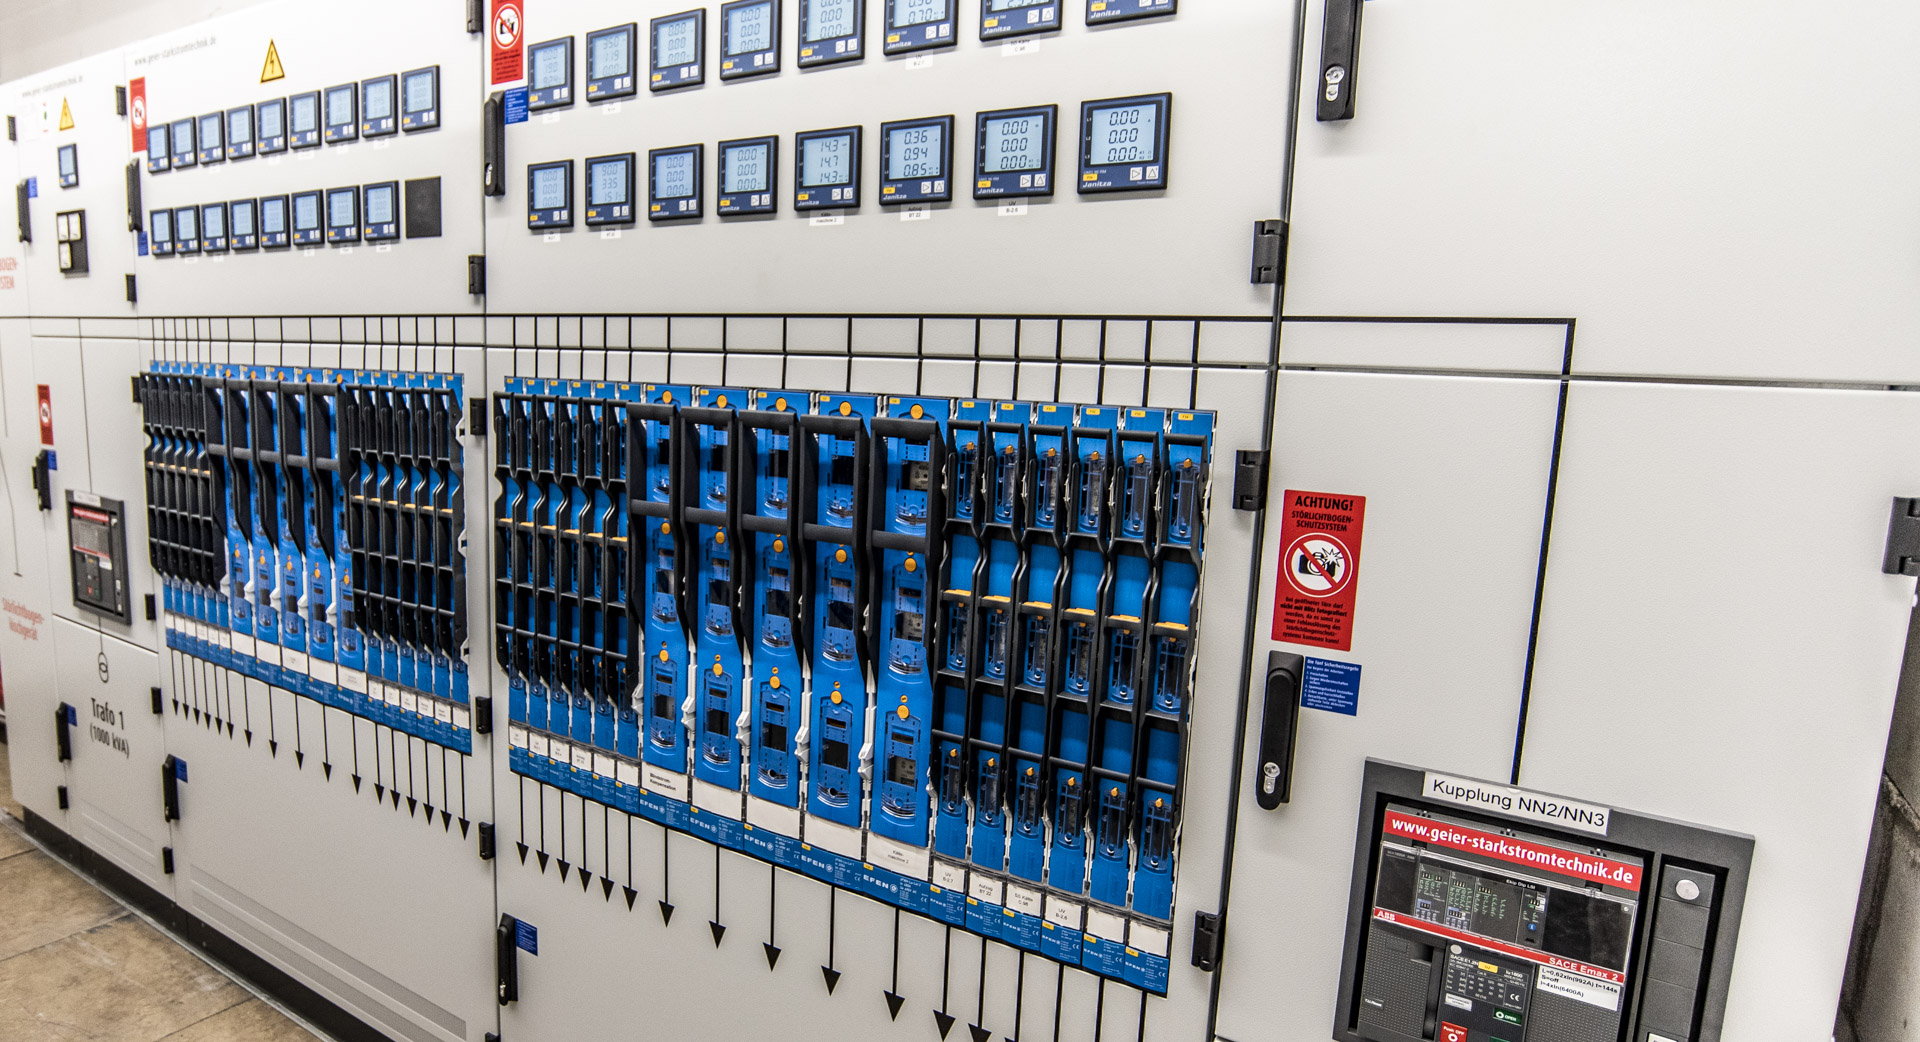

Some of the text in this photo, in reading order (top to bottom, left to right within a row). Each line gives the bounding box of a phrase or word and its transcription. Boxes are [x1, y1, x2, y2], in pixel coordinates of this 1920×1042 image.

[1091, 9, 1120, 18] Janitza
[984, 26, 1011, 34] Janitza
[1109, 110, 1139, 126] 0.00
[1002, 120, 1028, 135] 0.00
[904, 130, 928, 144] 0.36
[1109, 128, 1138, 144] 0.00
[1001, 138, 1028, 152] 0.00
[738, 148, 757, 161] 0.00
[904, 147, 928, 161] 0.94
[1108, 146, 1137, 162] 0.00
[1000, 155, 1027, 169] 0.00
[738, 163, 757, 176] 0.00
[904, 163, 926, 177] 0.85
[737, 178, 756, 190] 0.00
[1295, 496, 1353, 511] ACHTUNG!
[1292, 510, 1354, 524] STÖRLICHTBOGEN-
[1296, 520, 1347, 532] SCHUTZSYSTEM
[91, 697, 124, 730] Trafo 1
[640, 799, 658, 811] EFEN
[1433, 778, 1605, 827] Kupplung NN2/NN3
[690, 817, 710, 829] EFEN
[744, 834, 766, 847] EFEN
[1391, 817, 1633, 884] www.geier-starkstromtechnik.de
[801, 855, 825, 868] EFEN
[863, 874, 888, 889] EFEN
[1377, 910, 1395, 921] ABB
[1042, 935, 1056, 943] EFEN
[1125, 962, 1141, 971] EFEN
[1549, 957, 1578, 971] SACE
[1580, 965, 1608, 979] Emax
[1542, 975, 1559, 983] S=off
[1595, 983, 1618, 993] t=144s
